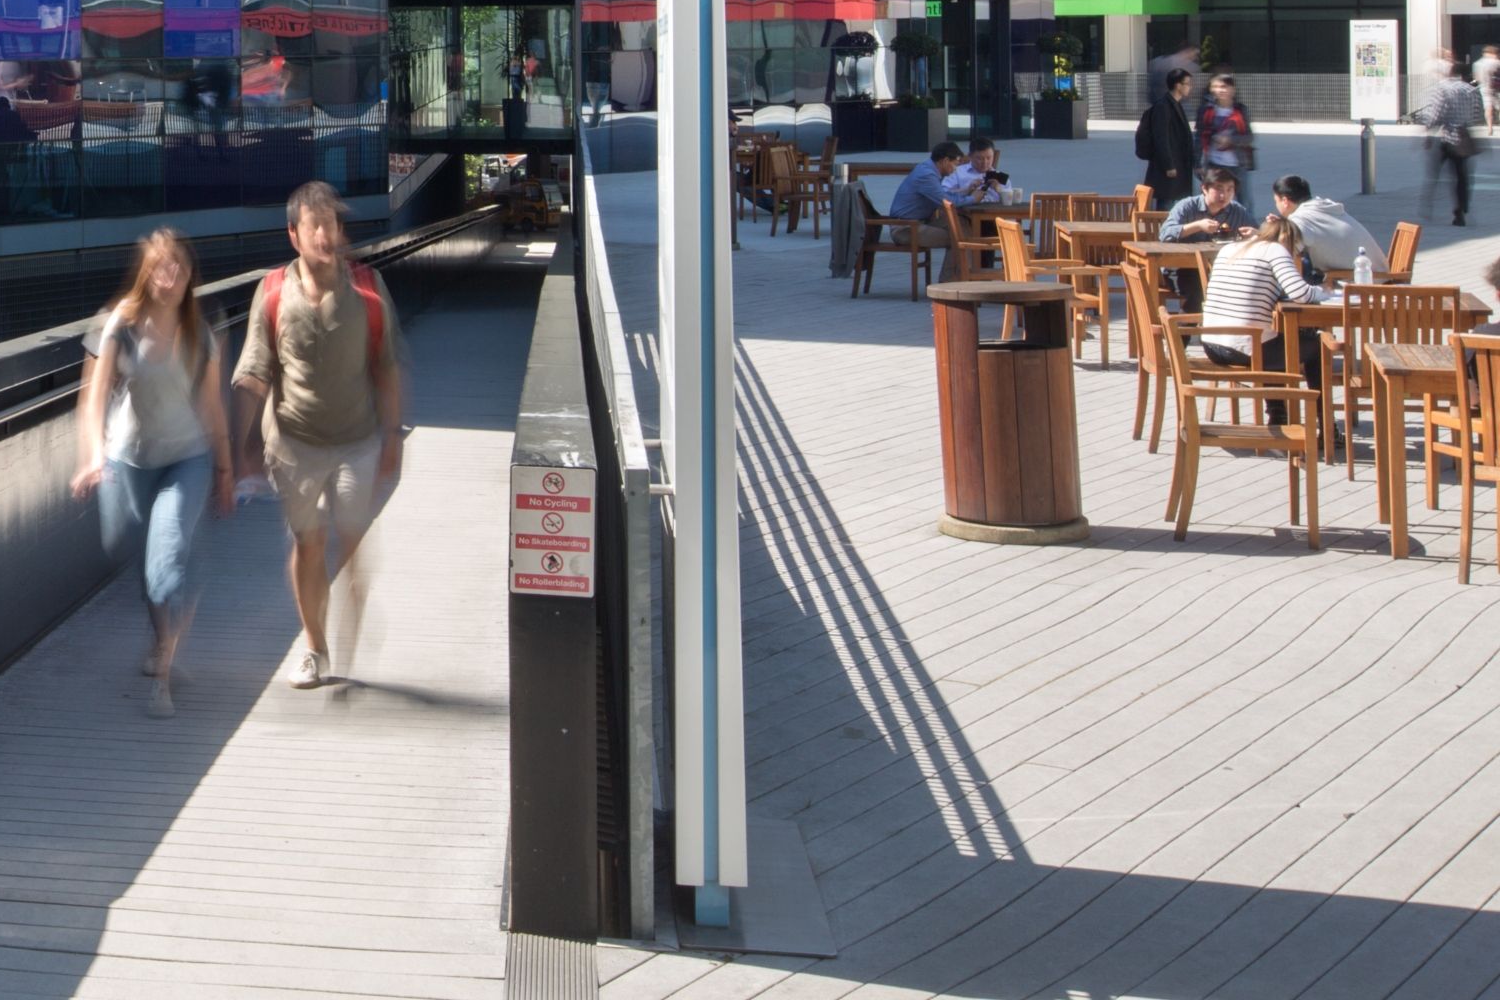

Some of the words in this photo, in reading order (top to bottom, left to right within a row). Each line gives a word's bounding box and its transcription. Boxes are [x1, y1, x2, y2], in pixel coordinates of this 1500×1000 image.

[529, 497, 542, 506] No
[544, 498, 578, 510] Cycling
[518, 537, 530, 545] No
[531, 537, 587, 549] Skateboarding
[519, 577, 531, 585] No
[532, 577, 586, 589] Rollerblading
